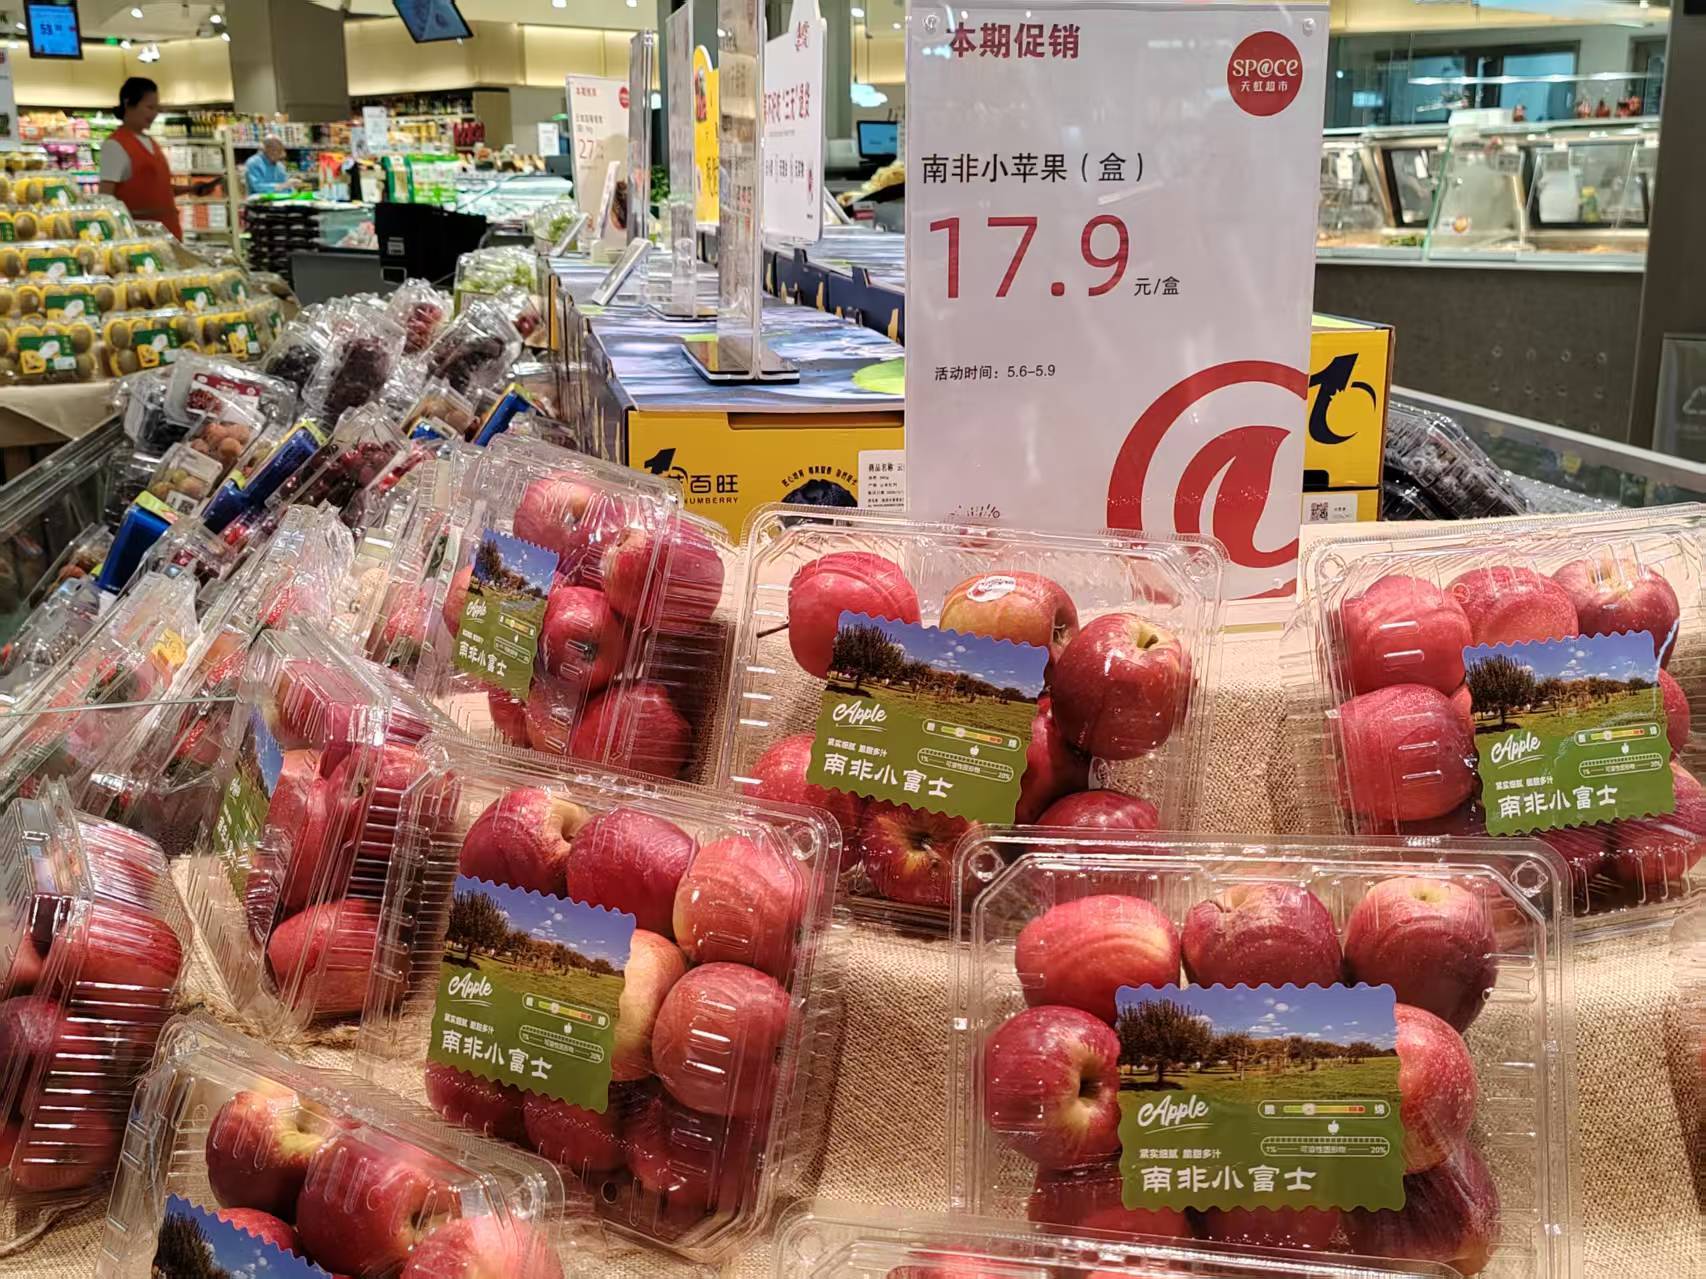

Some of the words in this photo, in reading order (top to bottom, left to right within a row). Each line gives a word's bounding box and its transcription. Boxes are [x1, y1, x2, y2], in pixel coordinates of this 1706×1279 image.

[949, 22, 1081, 59] 本期促销
[1232, 58, 1299, 78] SP@CE
[1240, 80, 1288, 92] 天虹超市
[929, 214, 1130, 299] 17.9
[1134, 276, 1181, 297] 元/盒
[832, 700, 888, 724] Apple
[1491, 732, 1541, 763] Apple
[823, 752, 953, 798] 南非小富士
[1498, 784, 1618, 819] 南非小富士
[448, 972, 493, 998] Apple
[441, 1028, 553, 1080] 南非小富士
[1137, 1094, 1209, 1127] Apple
[1141, 1164, 1317, 1193] 南非小富士
